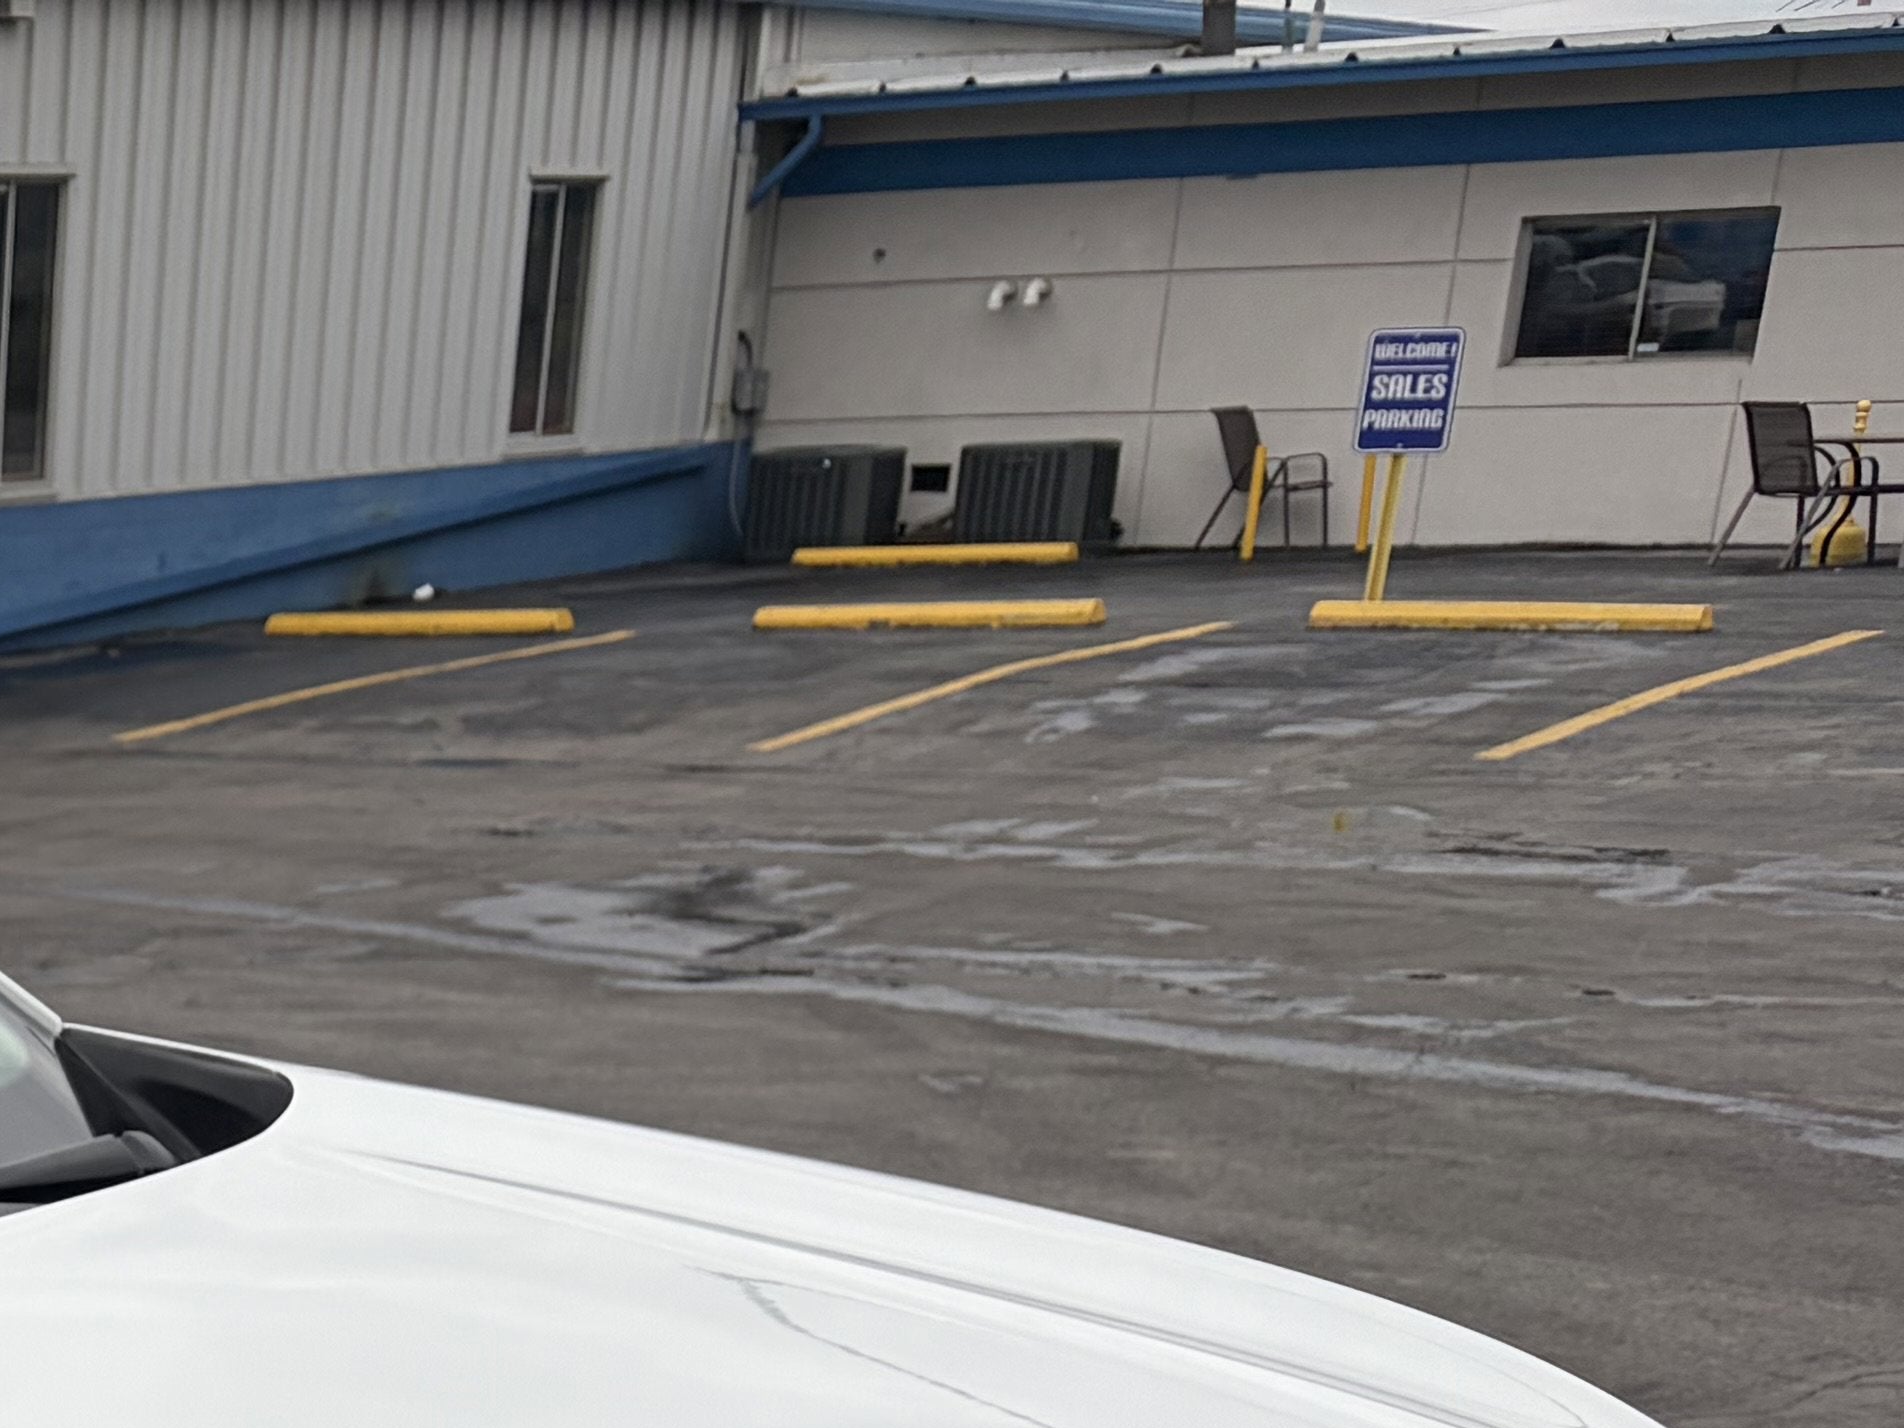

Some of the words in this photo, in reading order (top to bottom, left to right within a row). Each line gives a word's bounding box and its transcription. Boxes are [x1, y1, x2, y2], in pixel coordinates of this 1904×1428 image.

[1374, 341, 1458, 360] WELCOME!
[1370, 373, 1449, 401] SALES
[1361, 407, 1446, 431] PARKING
